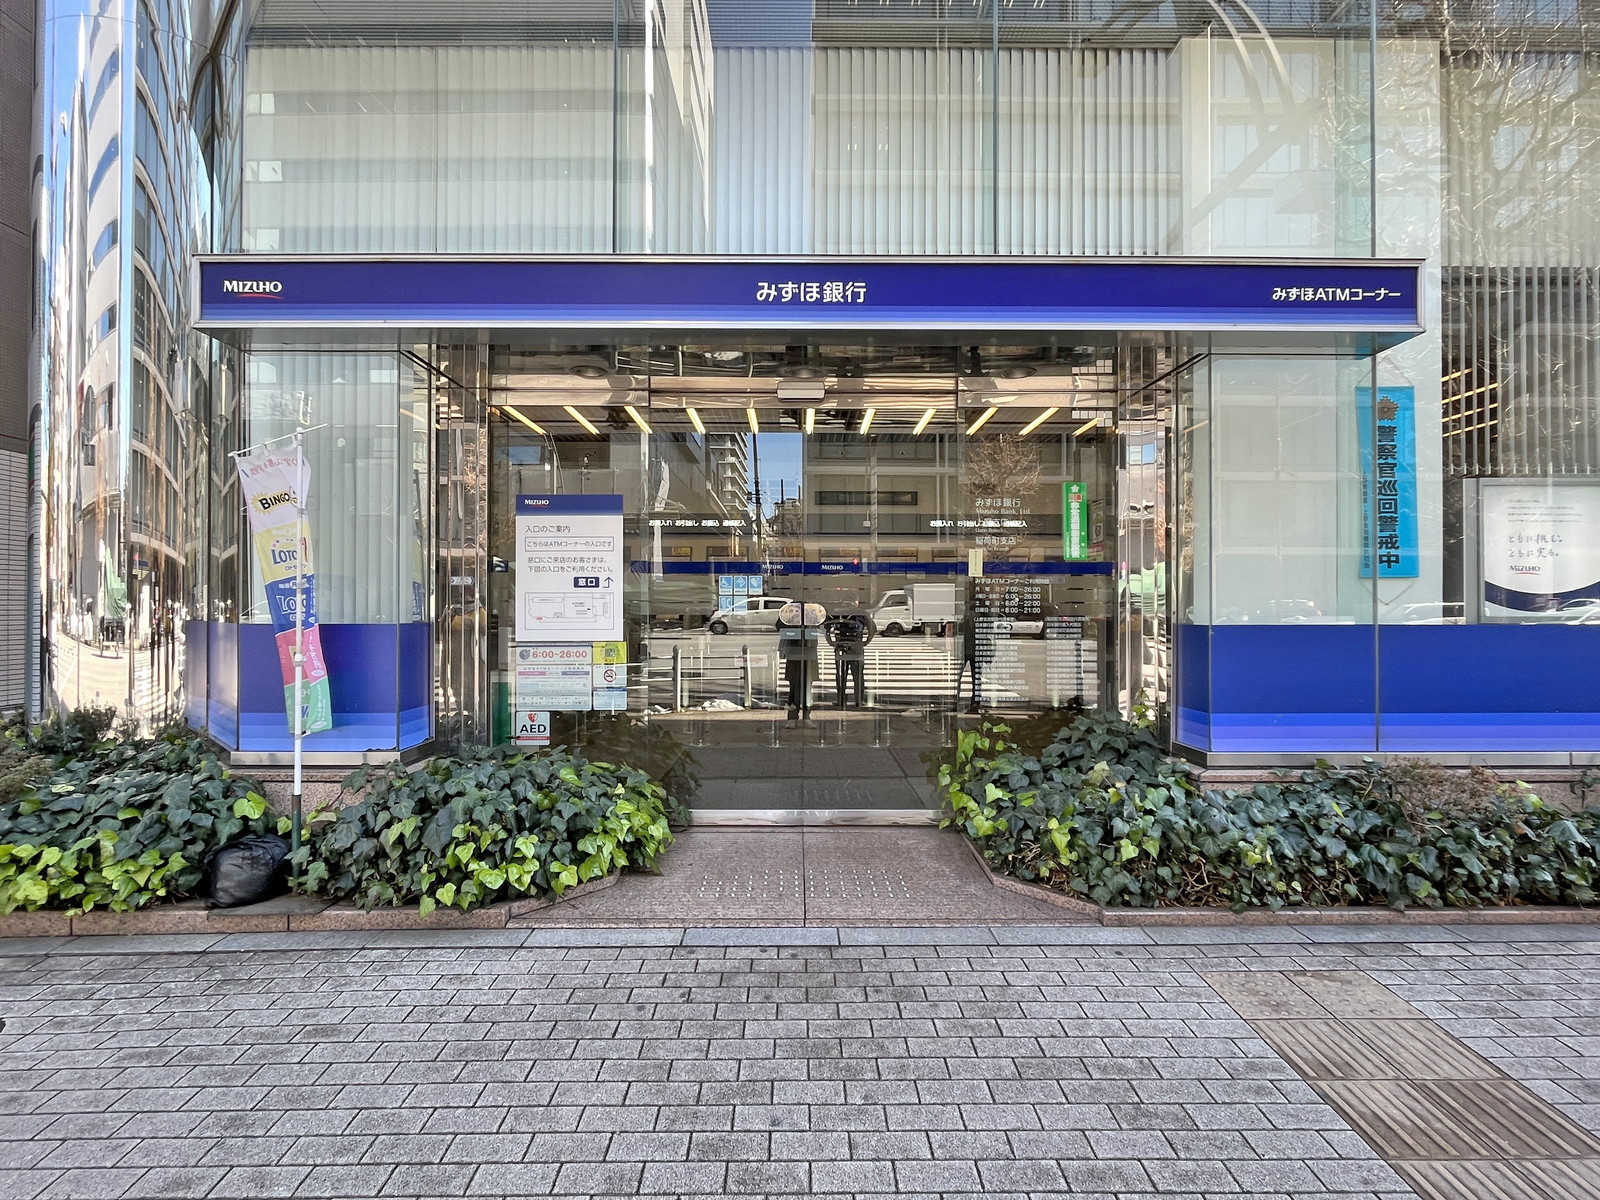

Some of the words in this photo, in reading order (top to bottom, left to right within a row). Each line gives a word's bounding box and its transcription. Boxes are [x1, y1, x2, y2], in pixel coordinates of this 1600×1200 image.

[223, 281, 283, 294] MIZUHO
[756, 281, 867, 304] みずほ銀行
[1272, 287, 1401, 302] みずほATMコーナー
[1377, 425, 1400, 569] 警察官巡回警戒中
[975, 498, 1022, 507] みずほ銀行
[525, 525, 571, 534] 入口のご案内
[527, 556, 607, 564] 窓口にご来店のお客さまは、
[527, 565, 613, 574] 下図の入口をご利用ください。
[577, 578, 596, 586] 窓口
[532, 650, 588, 658] 6:00~26:00
[520, 724, 547, 733] AED
